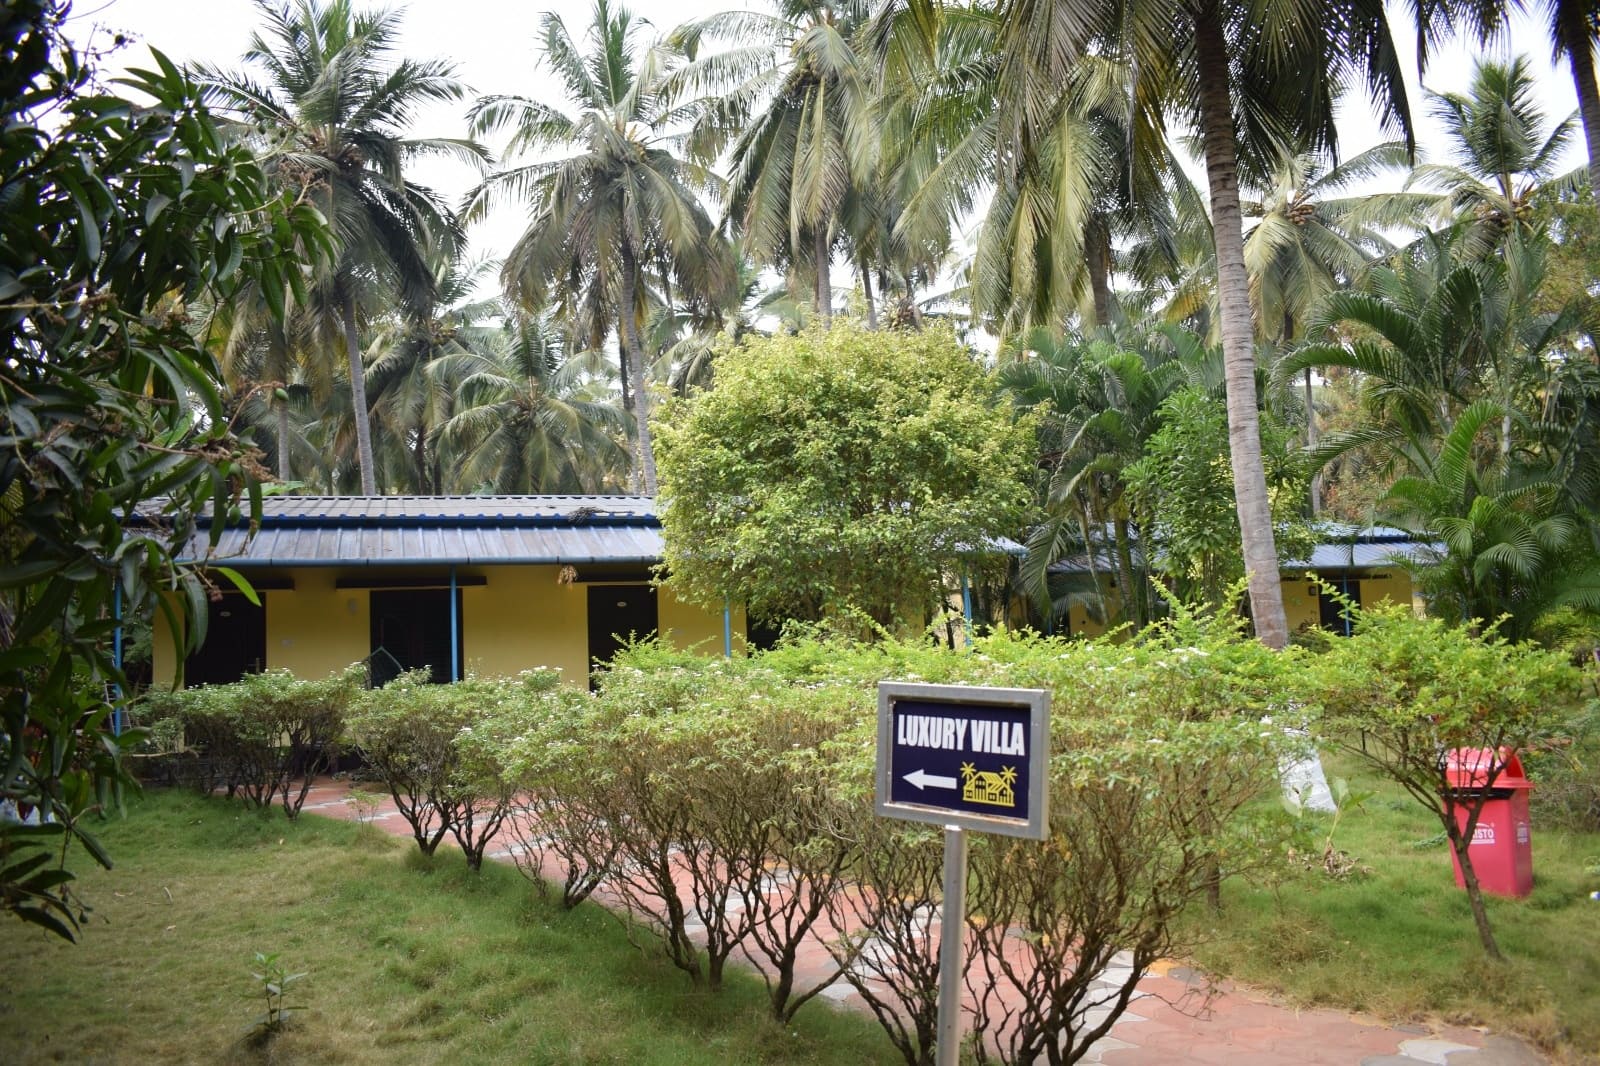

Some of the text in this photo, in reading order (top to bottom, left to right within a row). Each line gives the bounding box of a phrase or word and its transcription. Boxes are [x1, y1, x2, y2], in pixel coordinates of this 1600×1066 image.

[898, 714, 1025, 756] LUXURY VILLA
[1472, 828, 1494, 839] ISTO
